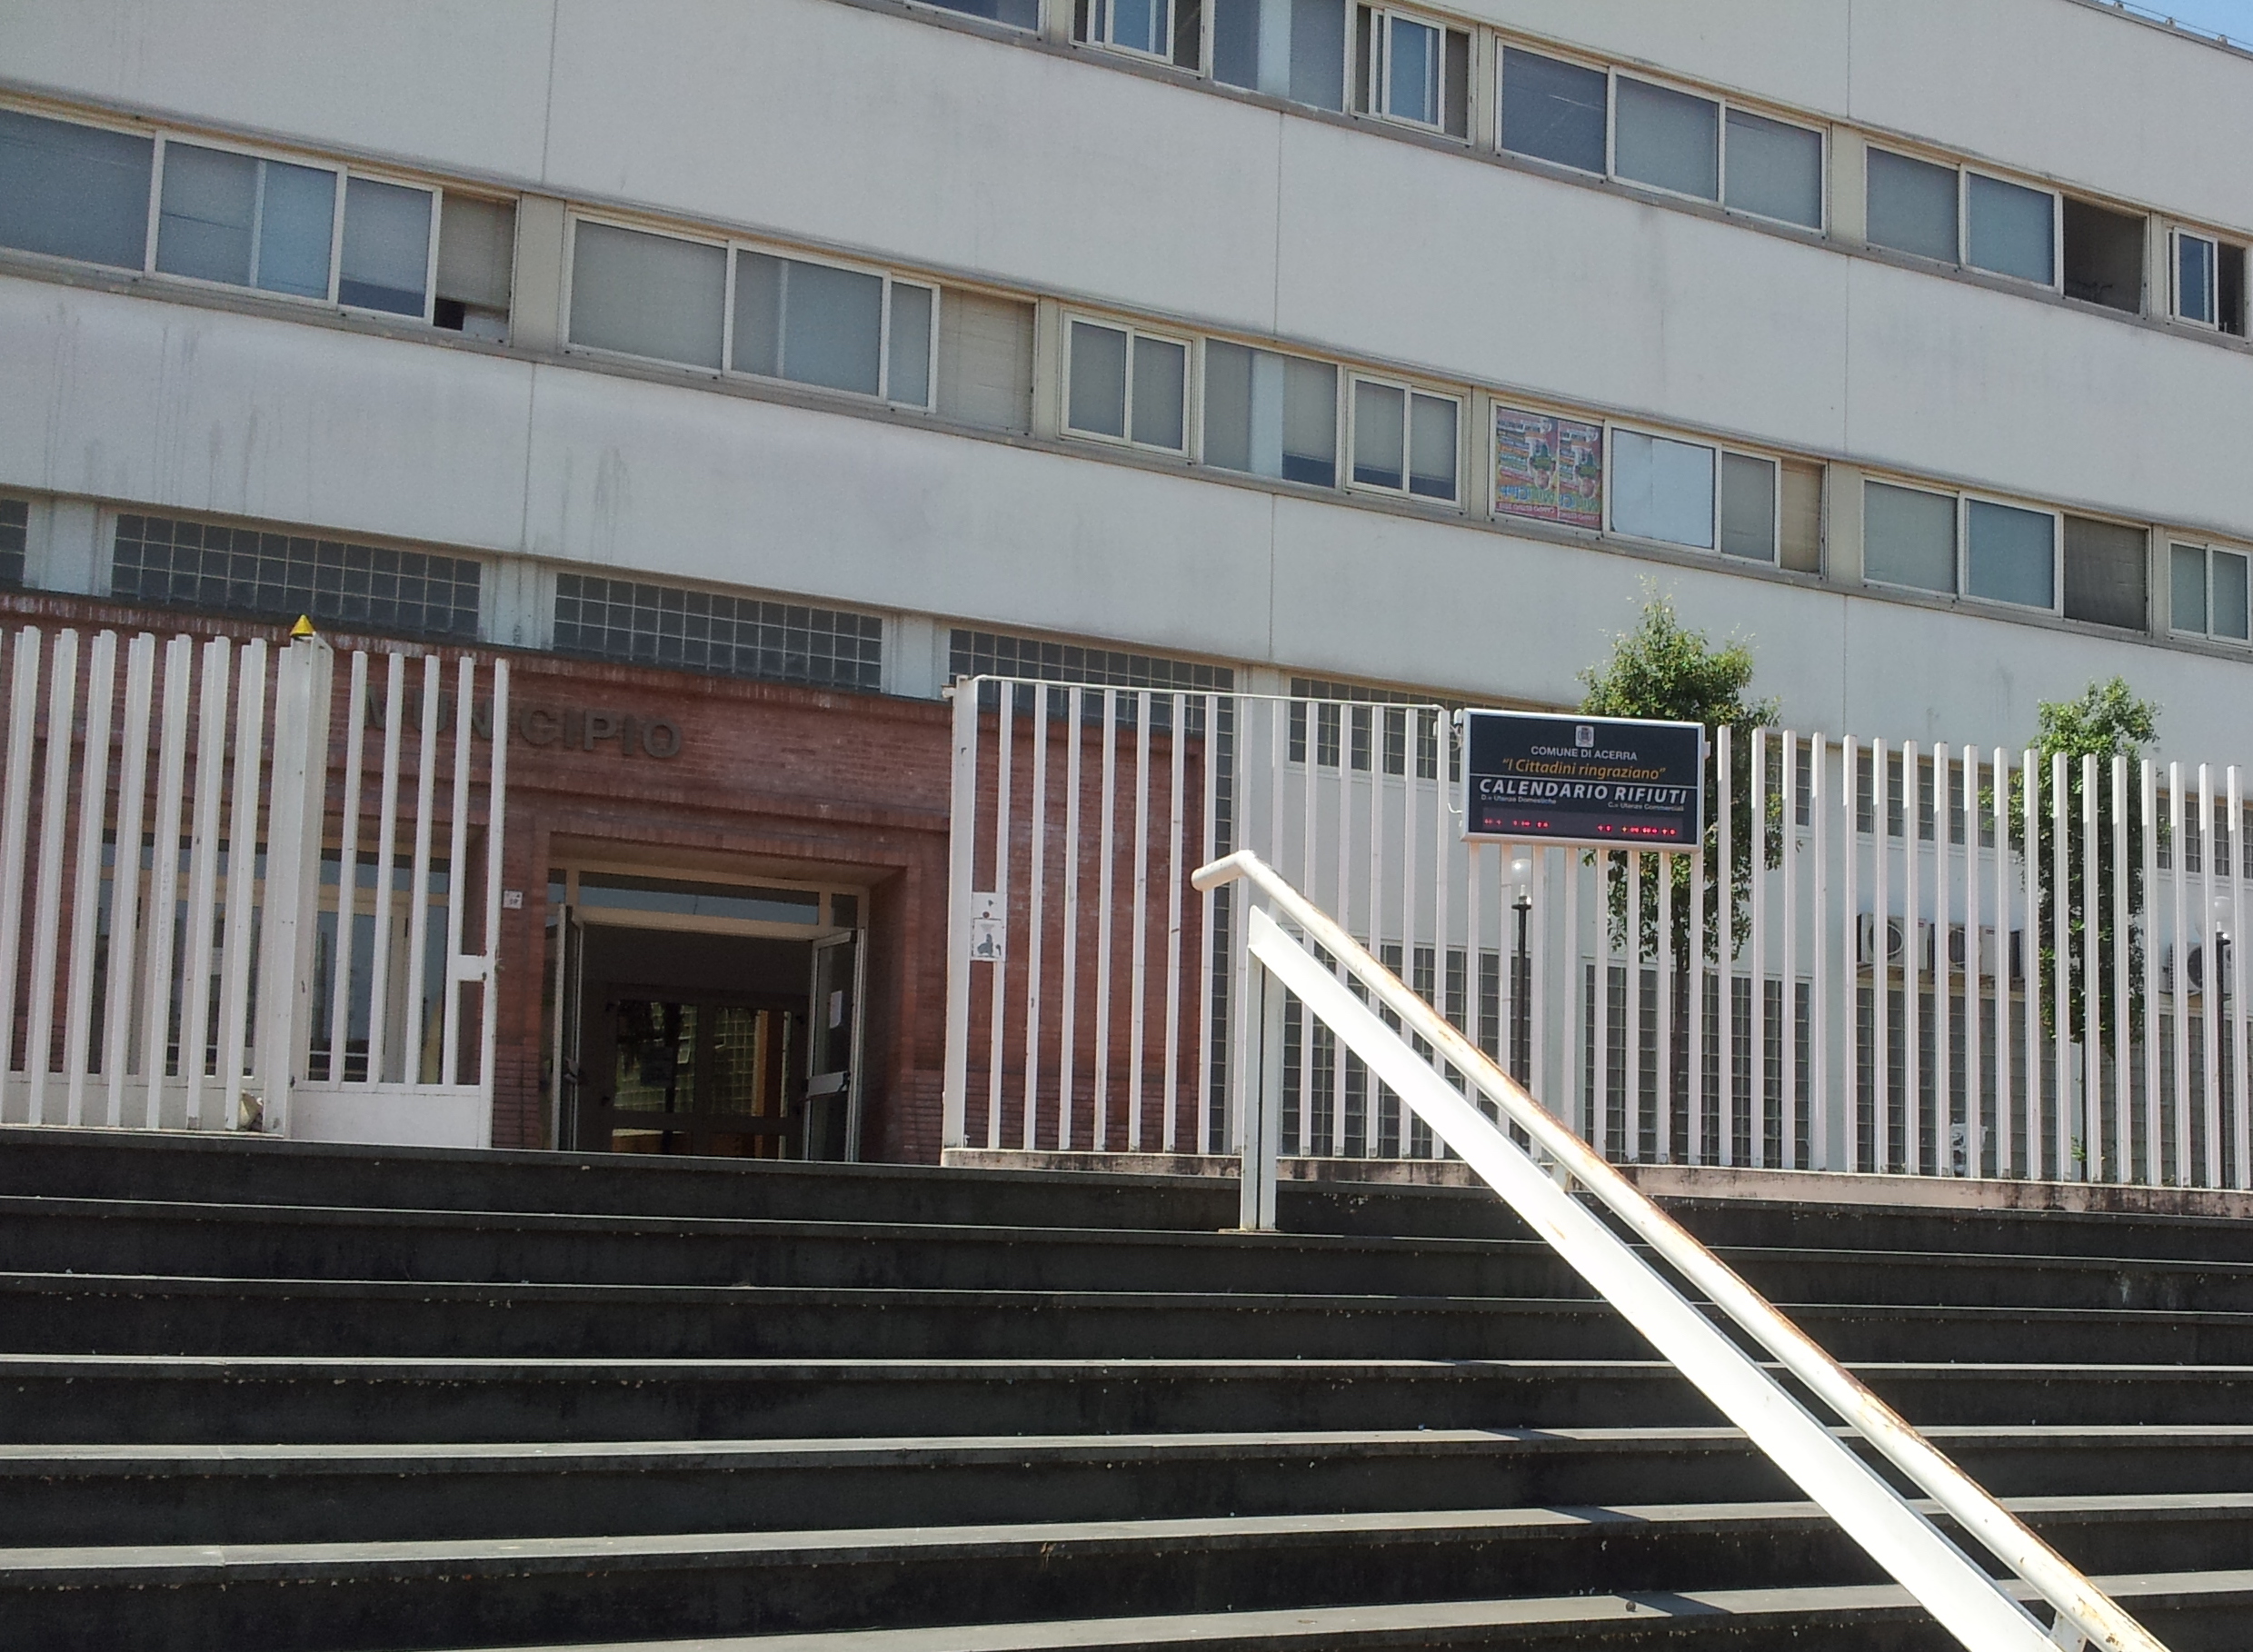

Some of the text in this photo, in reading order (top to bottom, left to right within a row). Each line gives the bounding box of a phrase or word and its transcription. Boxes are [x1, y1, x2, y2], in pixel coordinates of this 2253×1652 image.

[1530, 745, 1638, 761] COMUNE DI ACERRA
[1515, 759, 1577, 774] Cittadini
[1479, 778, 1687, 804] CALENDARIO RIFIUTI
